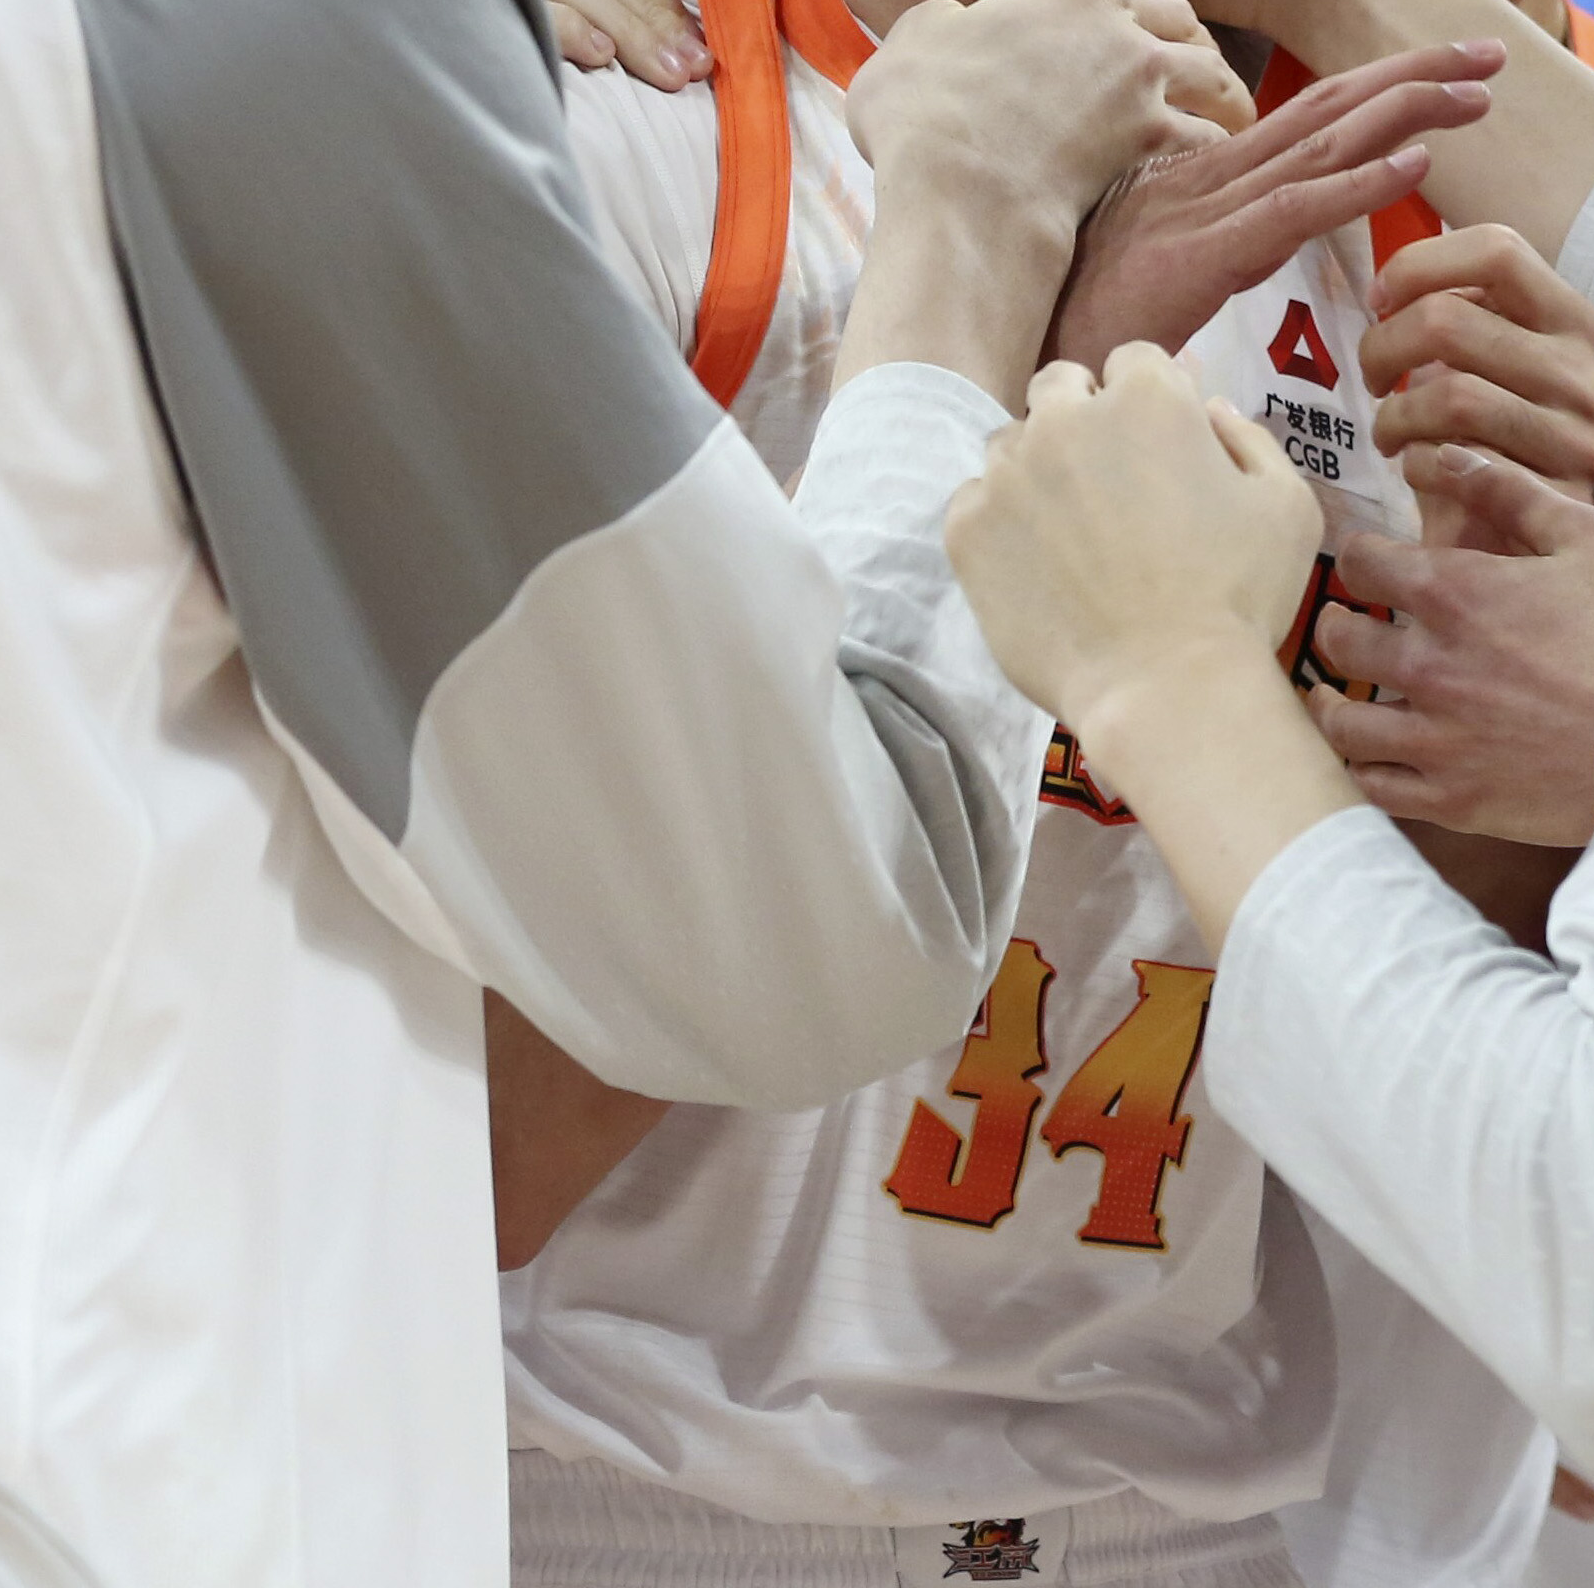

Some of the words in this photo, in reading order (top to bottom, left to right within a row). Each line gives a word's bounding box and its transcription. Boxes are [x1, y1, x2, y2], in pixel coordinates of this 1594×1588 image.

[1265, 392, 1355, 450] 广发银行
[1285, 435, 1340, 480] CGB
[883, 938, 1216, 1252] 34
